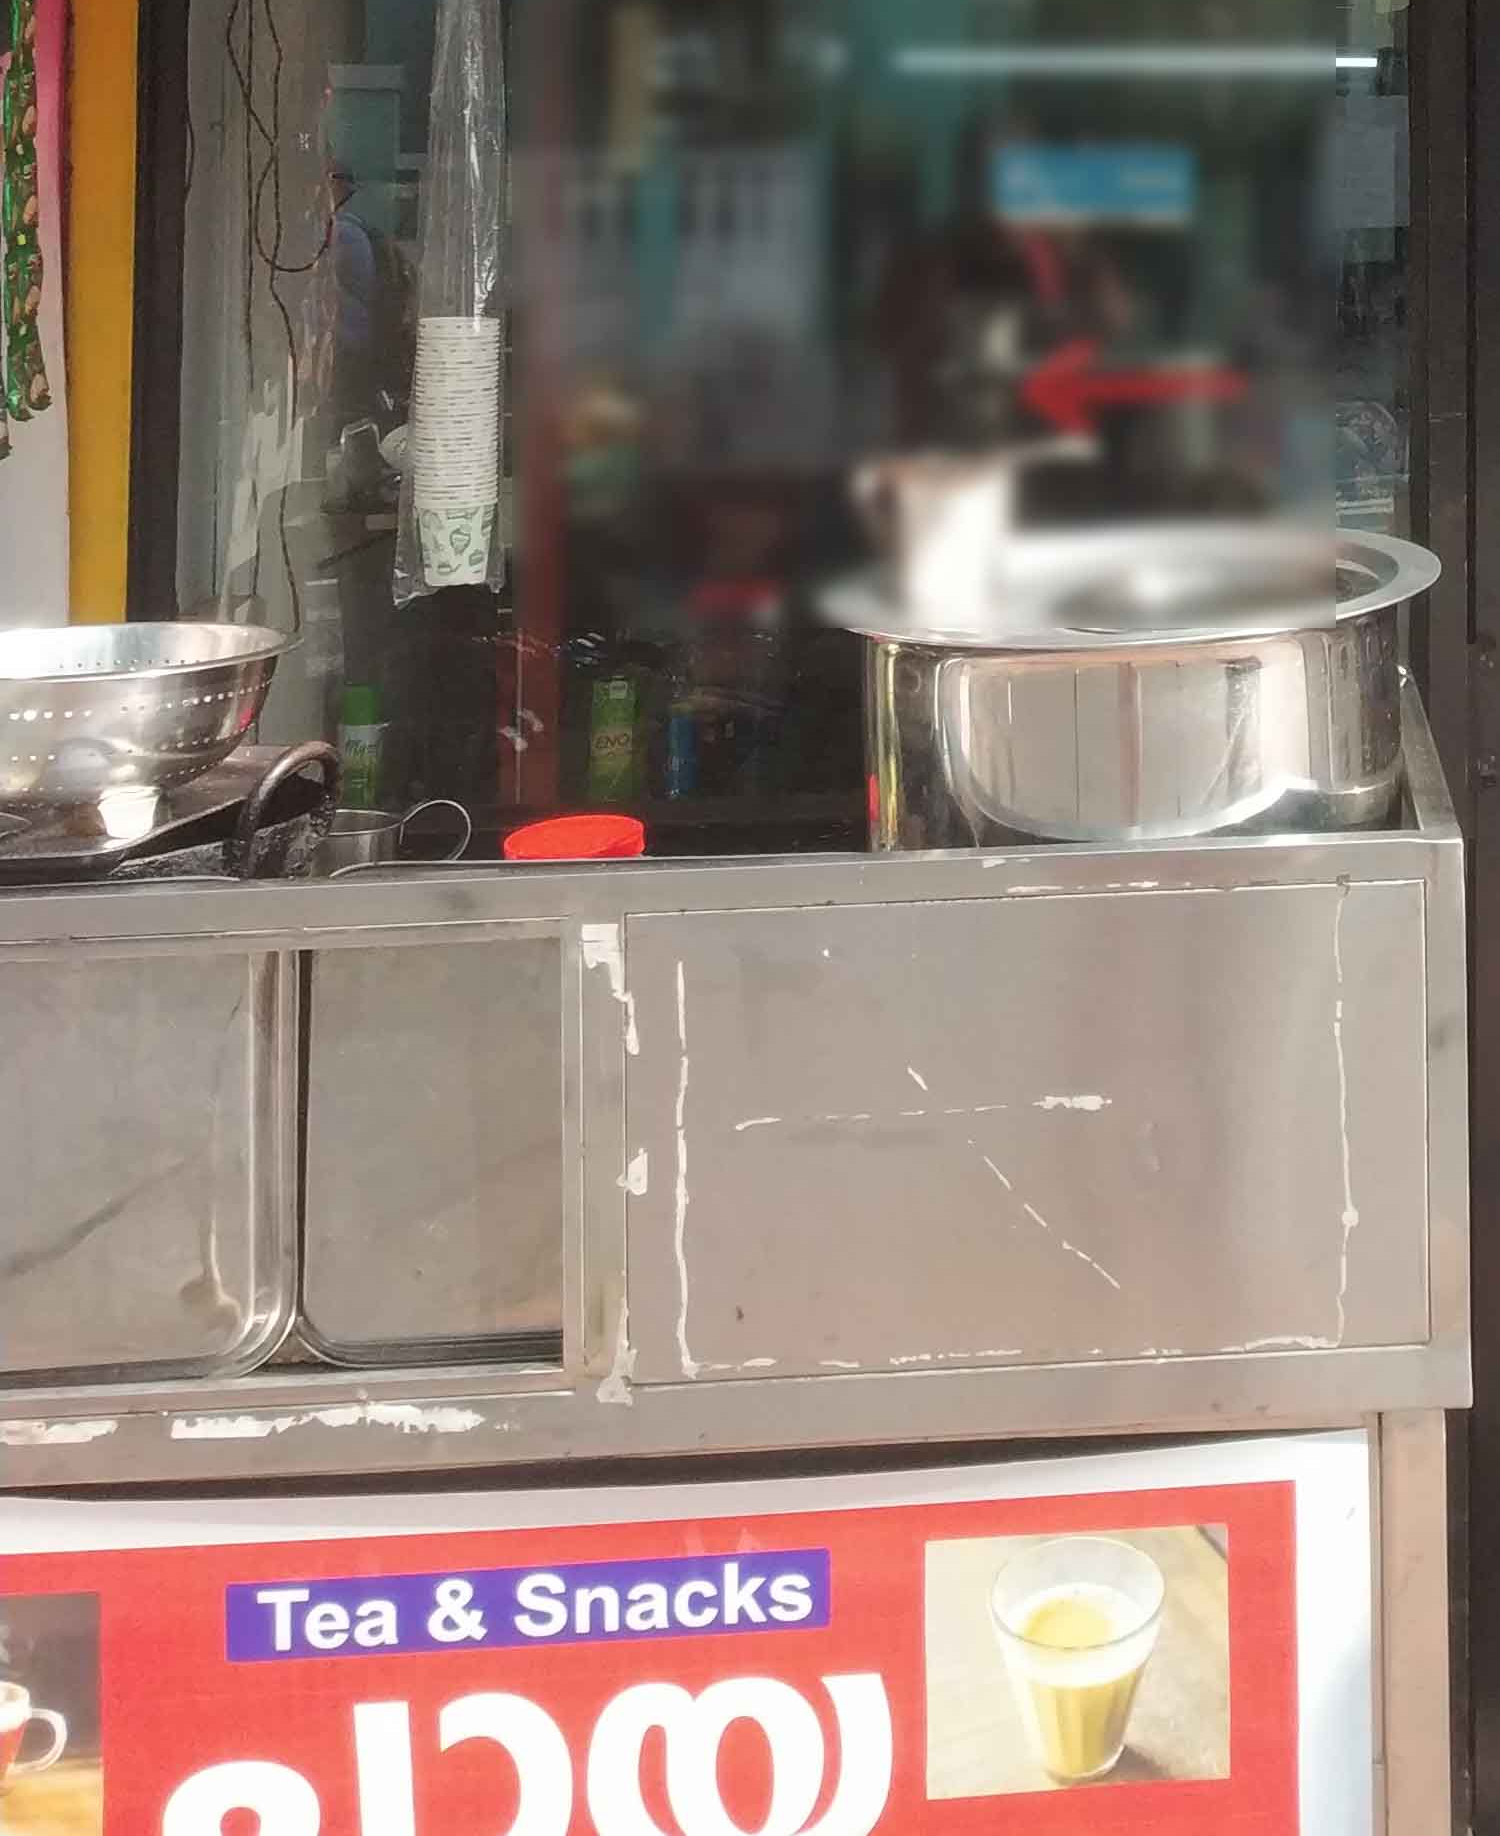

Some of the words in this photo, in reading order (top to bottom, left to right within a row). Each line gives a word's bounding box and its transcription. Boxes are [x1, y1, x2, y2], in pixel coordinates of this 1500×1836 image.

[256, 1588, 399, 1651] Tea
[427, 1578, 488, 1642] &
[514, 1562, 813, 1637] Snacks
